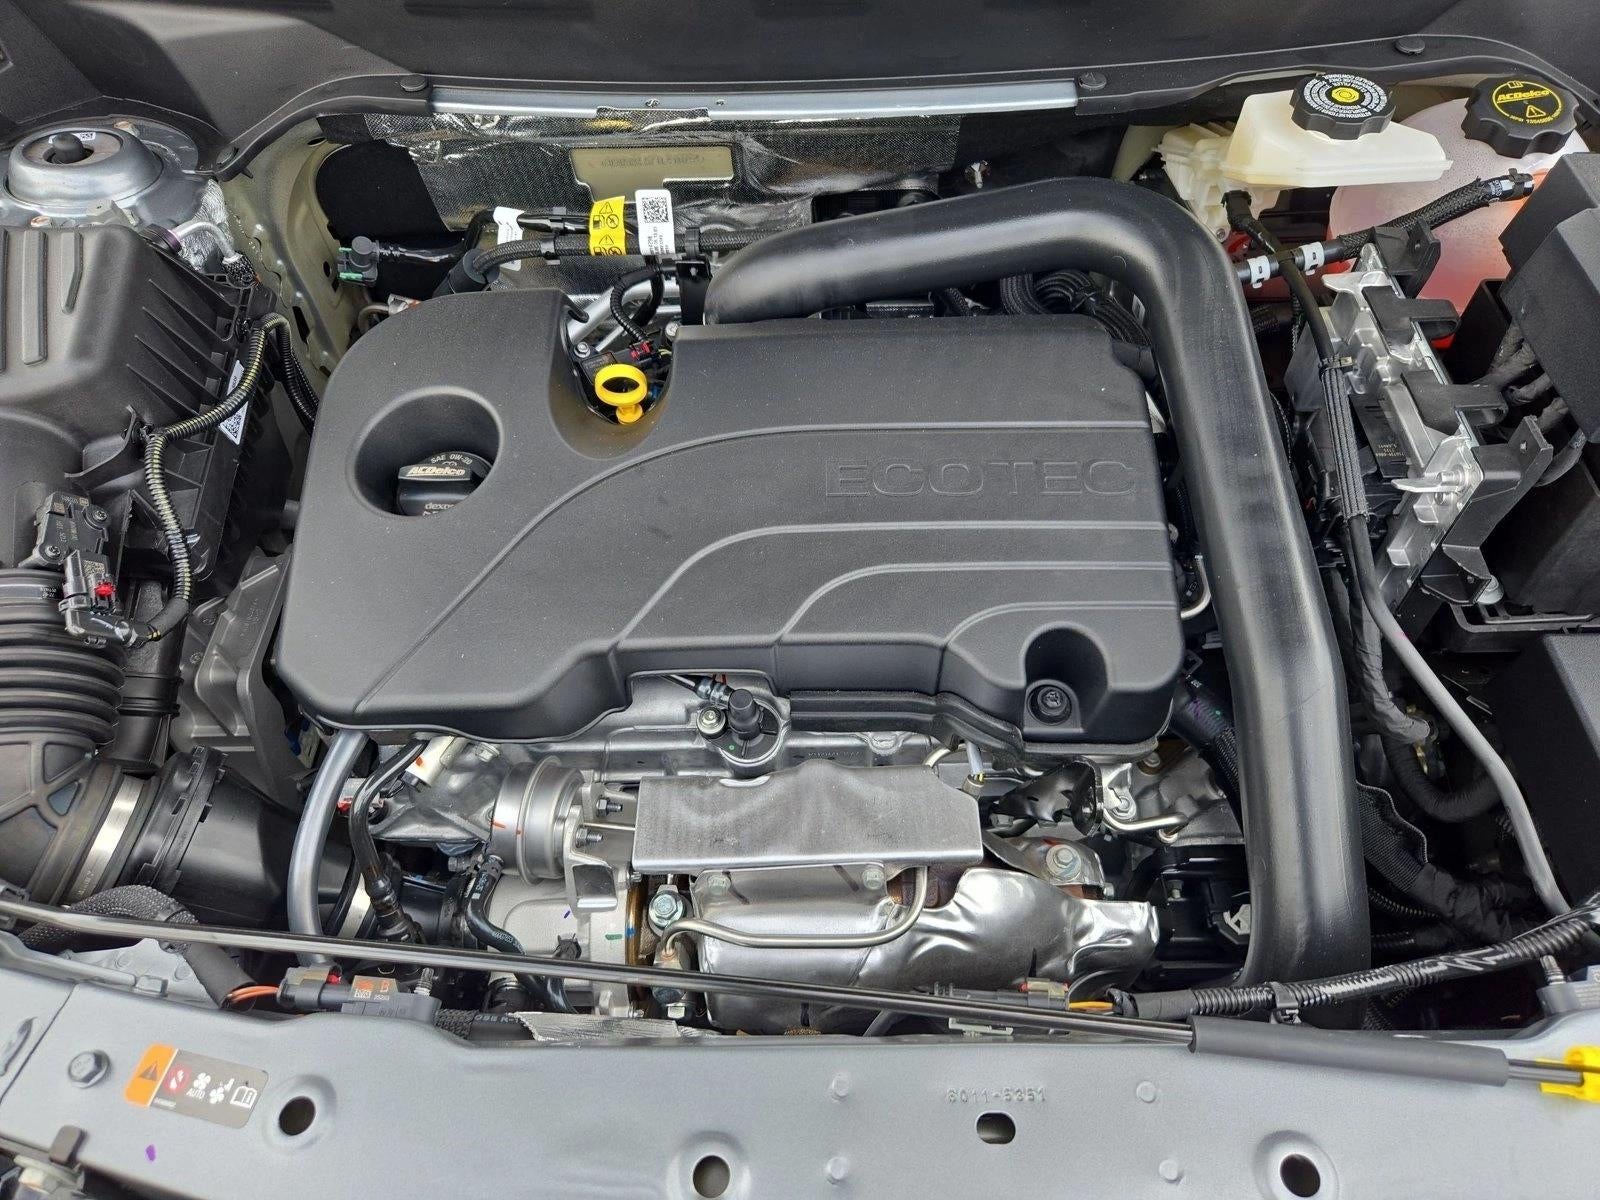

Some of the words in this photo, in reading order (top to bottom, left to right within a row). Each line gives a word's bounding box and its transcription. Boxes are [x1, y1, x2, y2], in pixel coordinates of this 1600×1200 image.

[1497, 90, 1550, 101] ACDelco
[431, 454, 446, 464] SAE
[406, 466, 466, 477] ACDelco
[825, 460, 1137, 496] ECOTEC
[186, 1087, 206, 1101] AUTO
